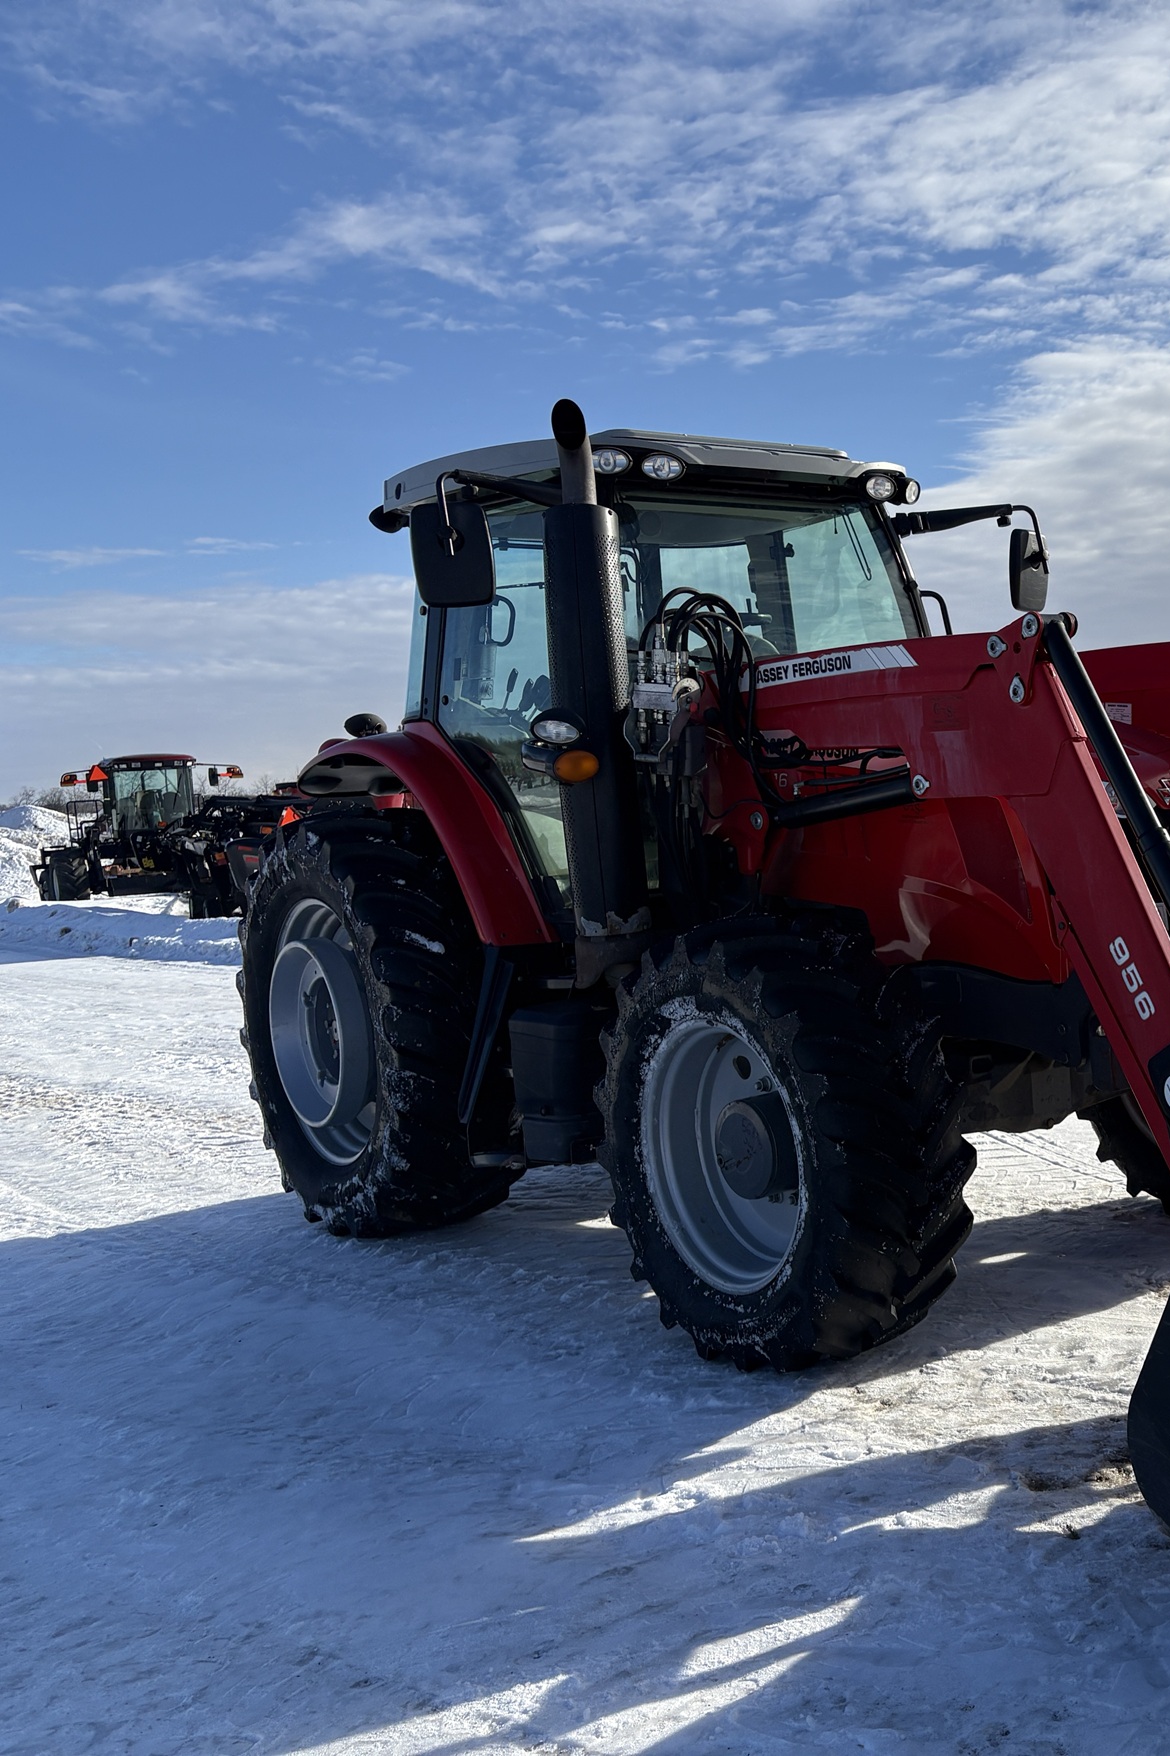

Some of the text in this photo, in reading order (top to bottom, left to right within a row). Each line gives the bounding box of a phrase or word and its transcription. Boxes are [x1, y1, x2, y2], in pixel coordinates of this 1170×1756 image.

[756, 655, 852, 684] ASSEY FERGUSON
[1109, 936, 1156, 1020] 956
